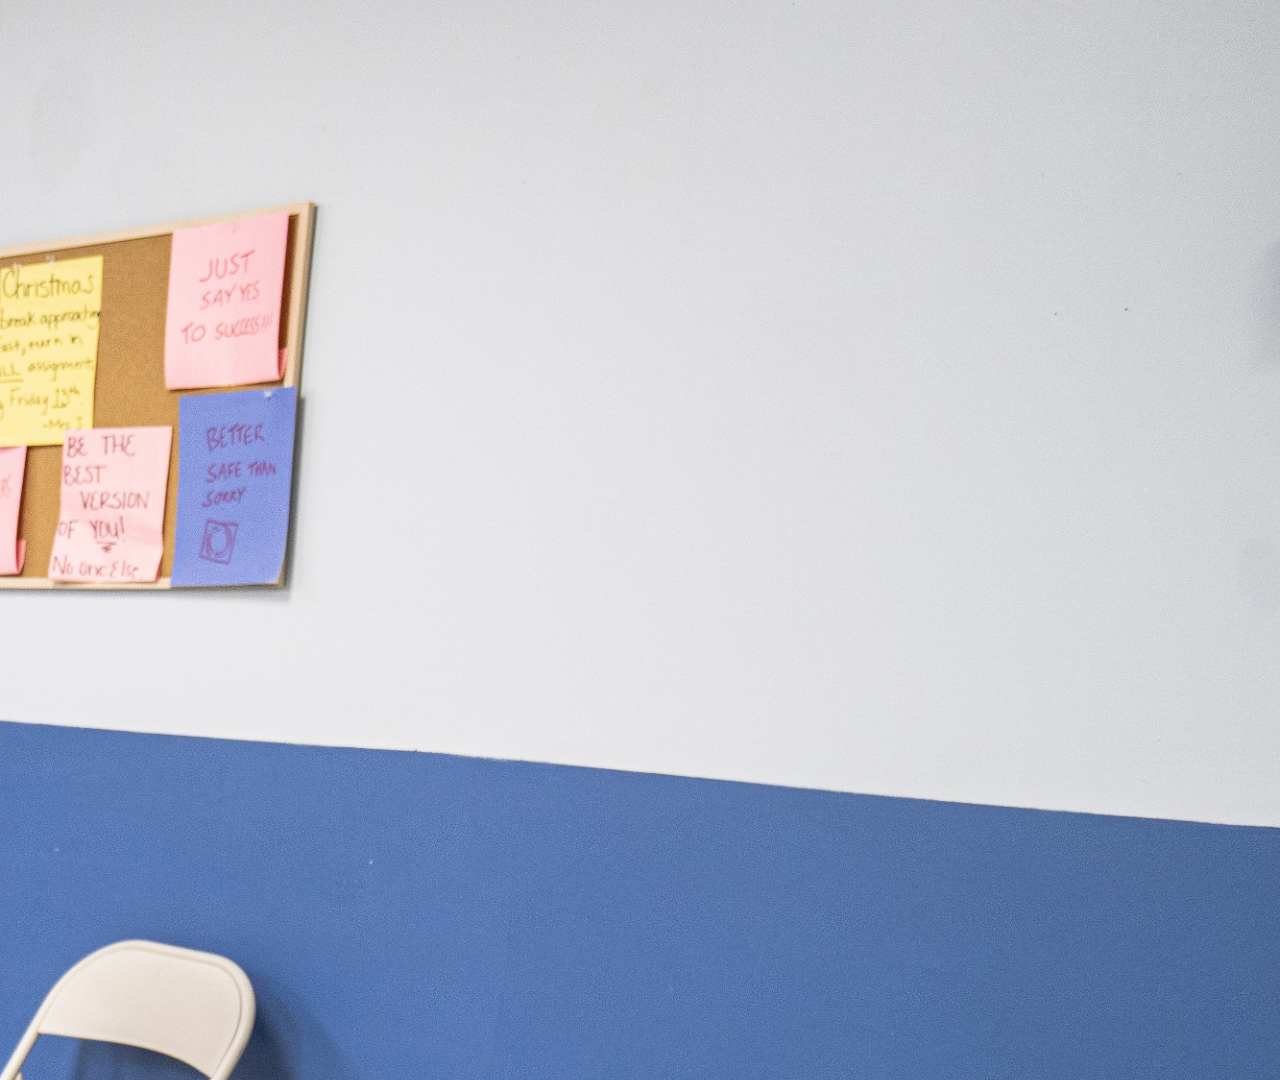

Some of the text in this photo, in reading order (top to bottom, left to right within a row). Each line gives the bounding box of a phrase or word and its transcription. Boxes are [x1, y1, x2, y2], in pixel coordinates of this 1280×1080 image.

[199, 249, 256, 284] JUST
[2, 270, 95, 300] Christmas
[200, 280, 261, 312] SAY YES
[180, 321, 207, 346] TO
[66, 433, 136, 458] BE THE
[206, 422, 266, 450] BETTER
[63, 465, 108, 485] BEST
[207, 460, 242, 484] SAFE
[78, 490, 152, 512] VERSION
[201, 486, 248, 509] SORRY
[58, 519, 79, 538] OF
